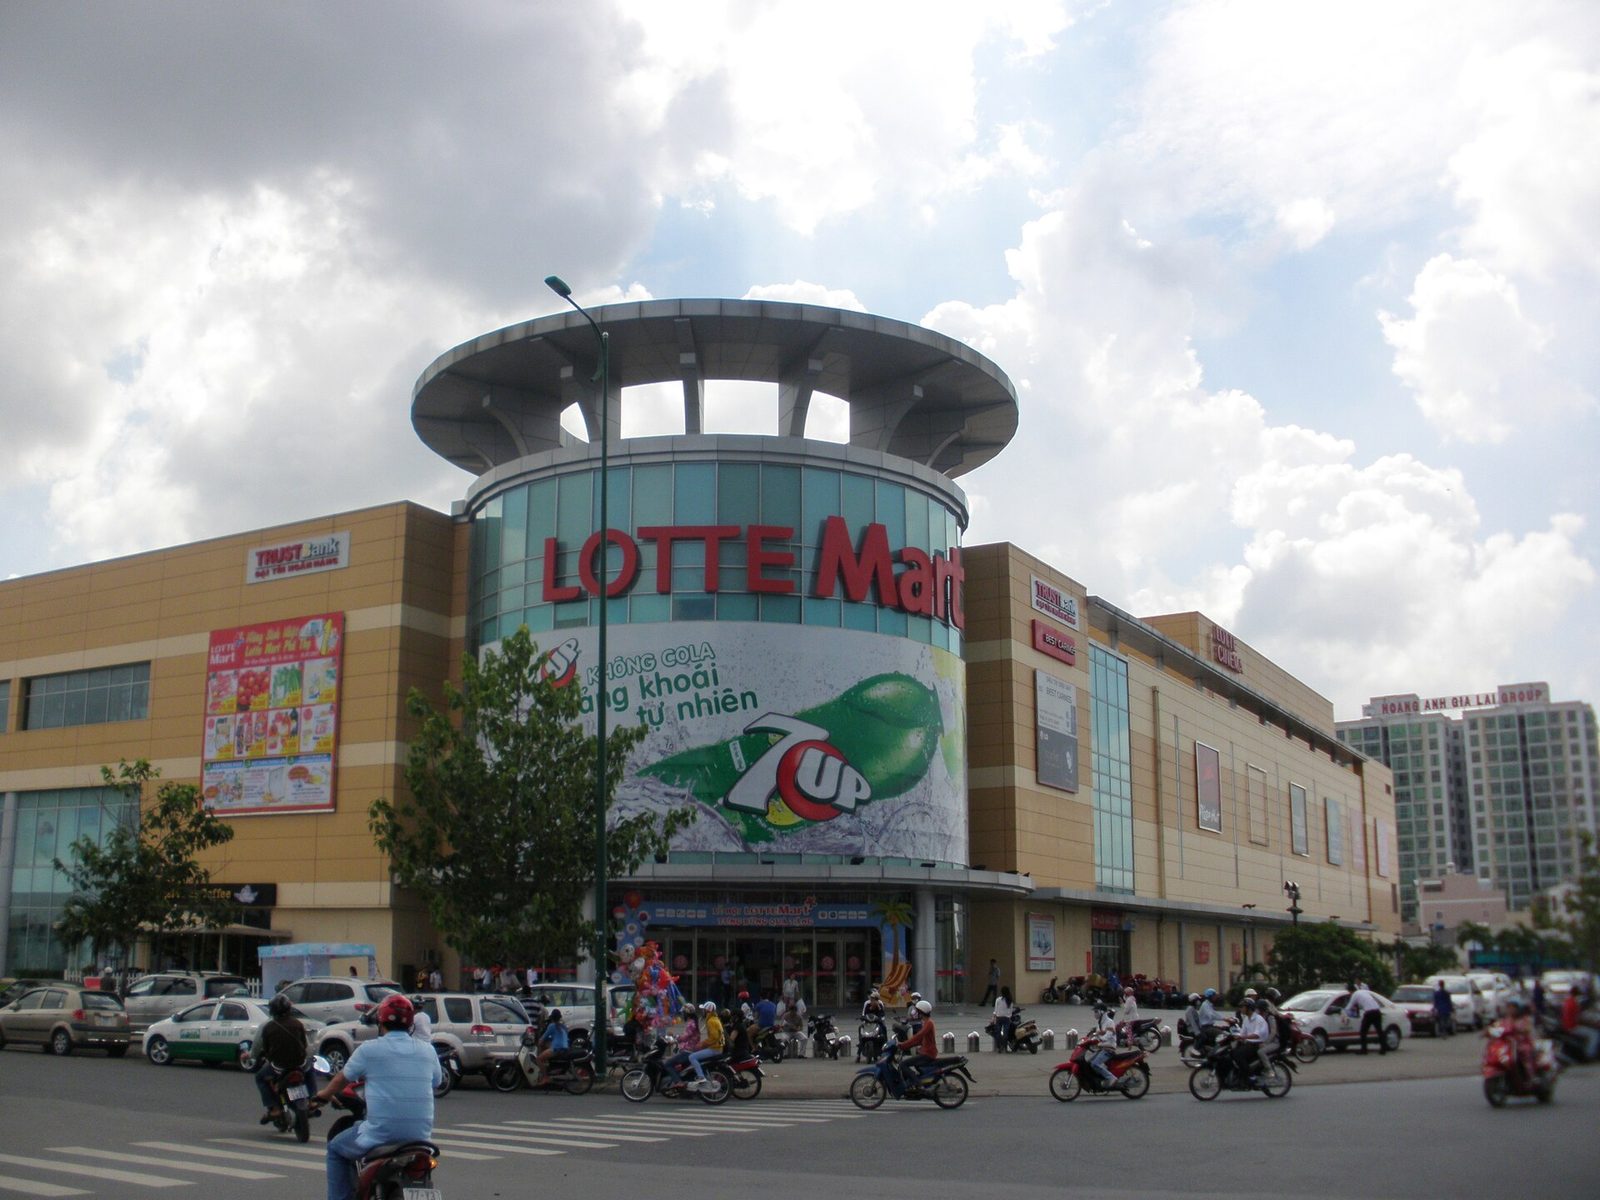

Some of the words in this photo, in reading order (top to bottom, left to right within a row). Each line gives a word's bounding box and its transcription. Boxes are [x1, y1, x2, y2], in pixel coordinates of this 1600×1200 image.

[542, 524, 796, 601] LOTTE
[816, 515, 965, 629] Mart
[210, 653, 236, 665] Mart
[586, 653, 657, 687] KHÔNG
[661, 641, 716, 668] COLA
[638, 663, 719, 700] khoái
[1424, 699, 1447, 711] ANH
[1451, 696, 1472, 708] GIA
[1476, 693, 1497, 706] LAI
[1501, 689, 1543, 704] GROUP
[636, 702, 665, 731] tự
[677, 687, 759, 721] nhiên
